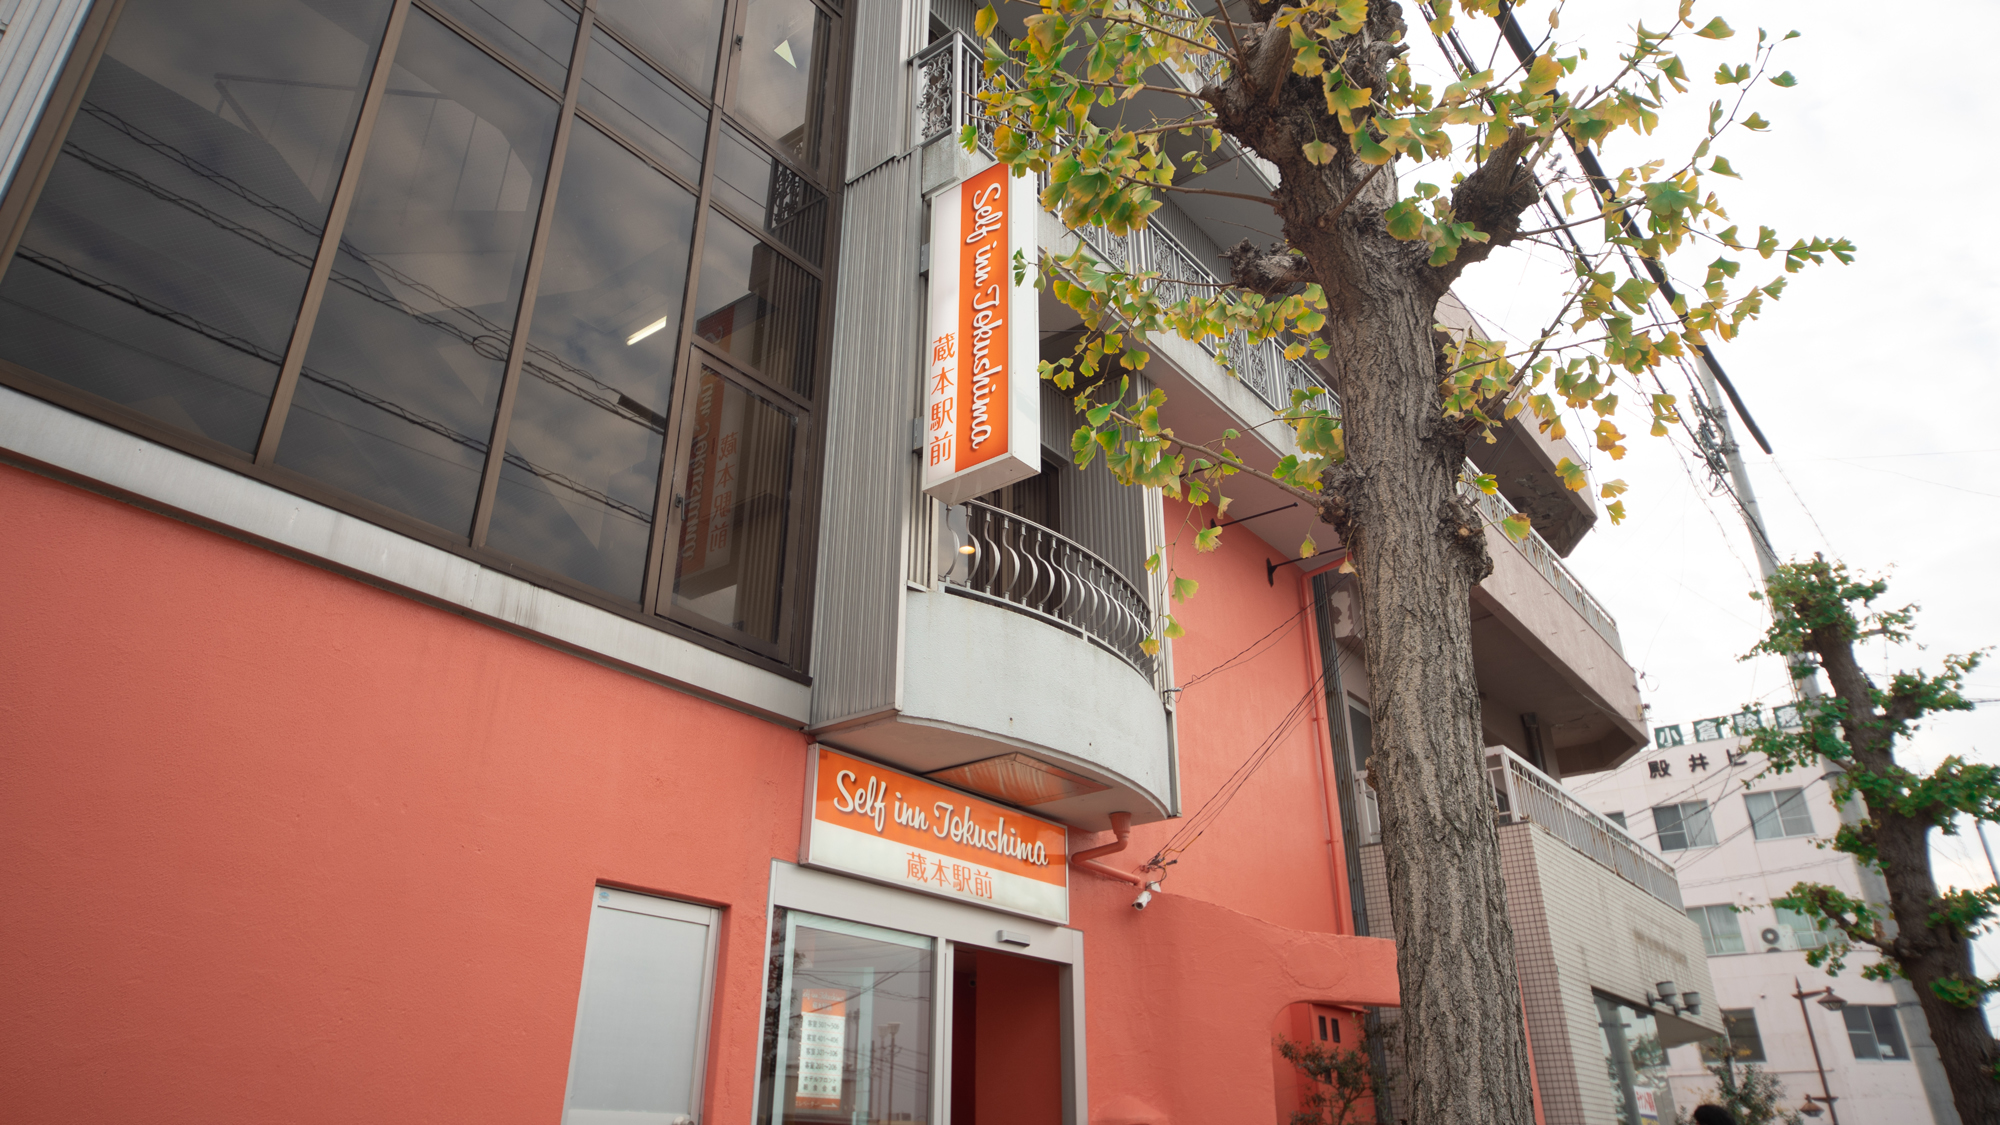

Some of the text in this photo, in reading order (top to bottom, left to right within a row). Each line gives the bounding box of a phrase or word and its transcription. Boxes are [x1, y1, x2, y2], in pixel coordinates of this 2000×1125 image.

[966, 182, 1002, 450] Self inn Tokushima
[930, 332, 956, 467] 蔵本駅前
[834, 770, 1048, 865] Self inn Tokushima
[906, 852, 992, 899] 蔵本駅前
